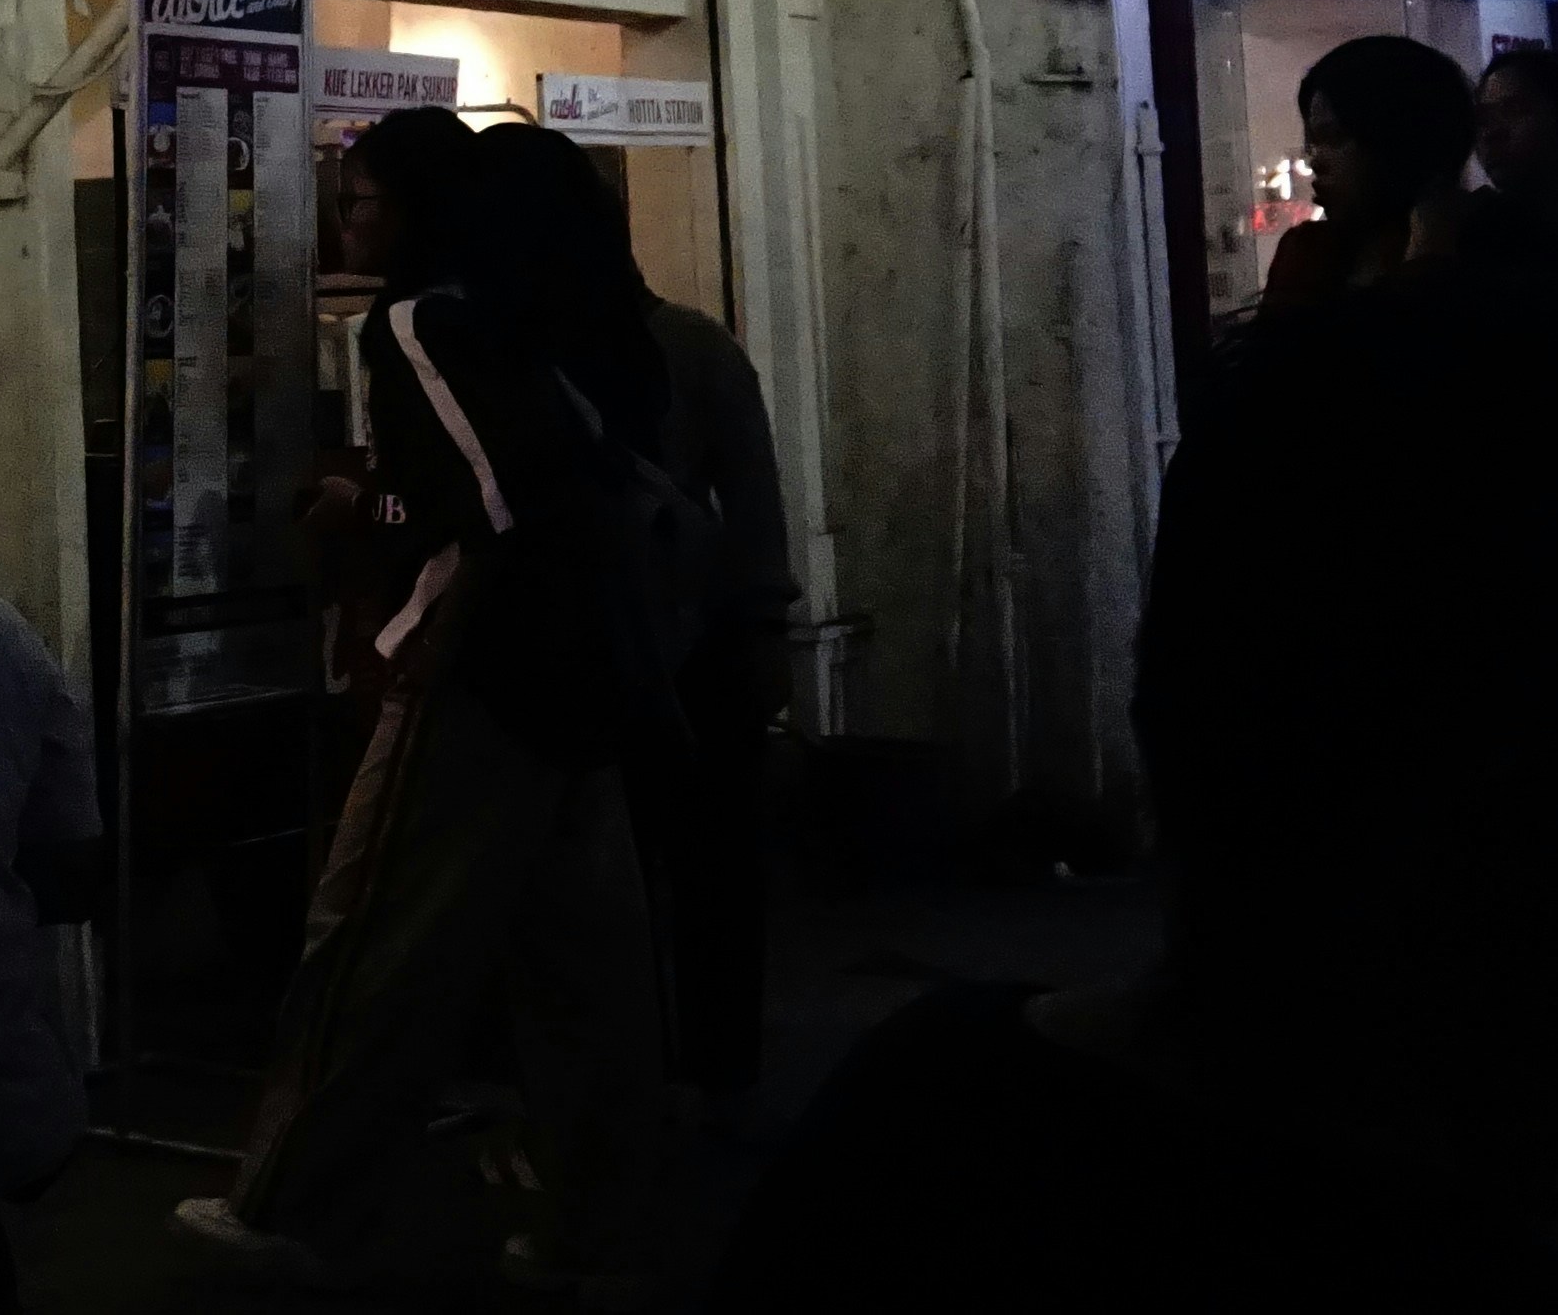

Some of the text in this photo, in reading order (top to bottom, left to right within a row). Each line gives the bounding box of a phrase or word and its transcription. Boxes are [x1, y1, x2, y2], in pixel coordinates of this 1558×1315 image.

[323, 69, 348, 97] KUE
[350, 69, 394, 99] LEKKER
[397, 71, 419, 101] PAK
